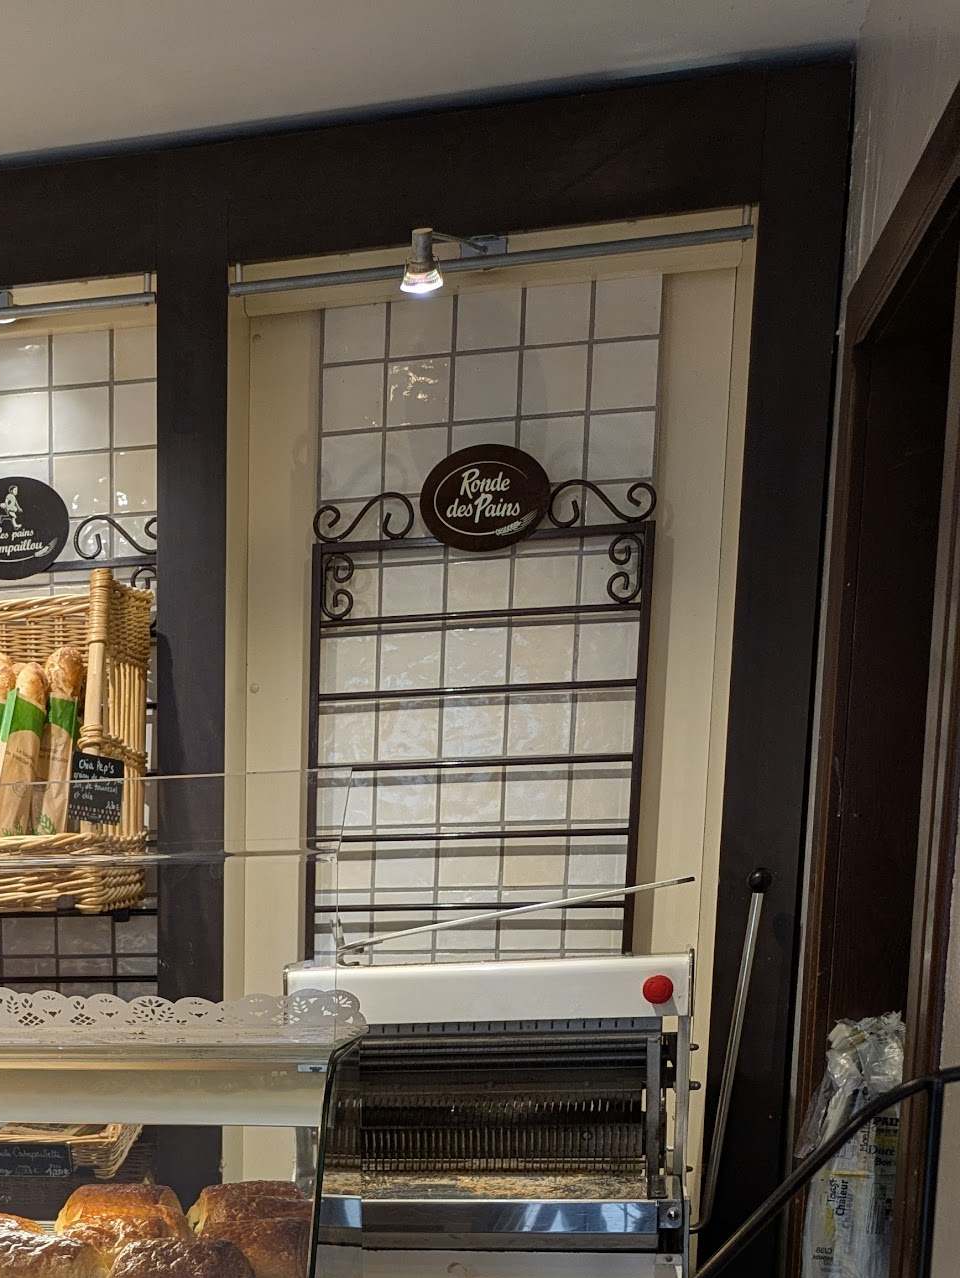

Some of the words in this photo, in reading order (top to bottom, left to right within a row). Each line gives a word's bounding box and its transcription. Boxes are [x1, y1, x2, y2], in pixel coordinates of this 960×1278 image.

[460, 468, 511, 500] Ronde
[446, 498, 473, 518] des
[474, 493, 521, 524] Pains
[11, 528, 35, 541] pains
